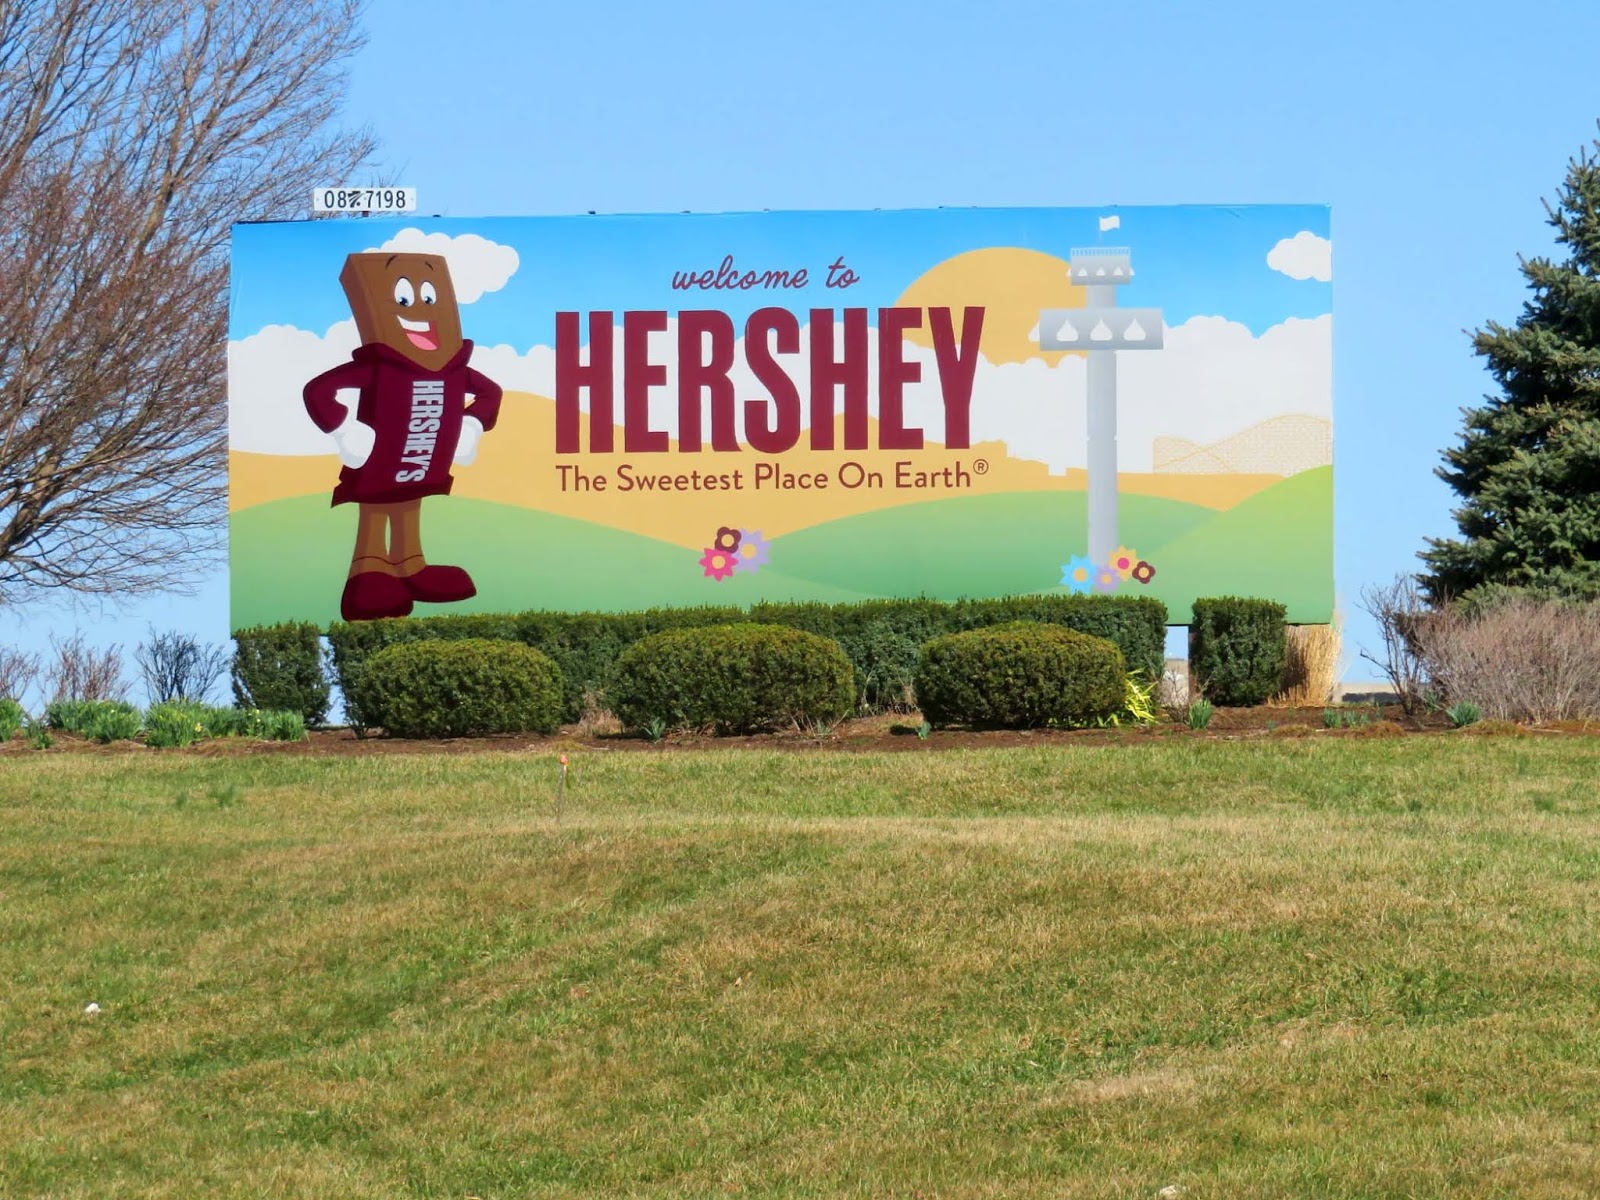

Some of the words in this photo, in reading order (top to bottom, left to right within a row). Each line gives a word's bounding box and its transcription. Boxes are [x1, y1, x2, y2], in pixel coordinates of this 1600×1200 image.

[365, 190, 406, 209] 7198
[671, 254, 810, 291] welcome
[825, 255, 861, 289] to
[555, 306, 986, 454] HERSHEY
[395, 381, 445, 483] HERSHEY'S
[555, 465, 608, 493] The
[616, 464, 744, 492] Sweetest
[754, 463, 829, 490] Place
[838, 461, 884, 489] On
